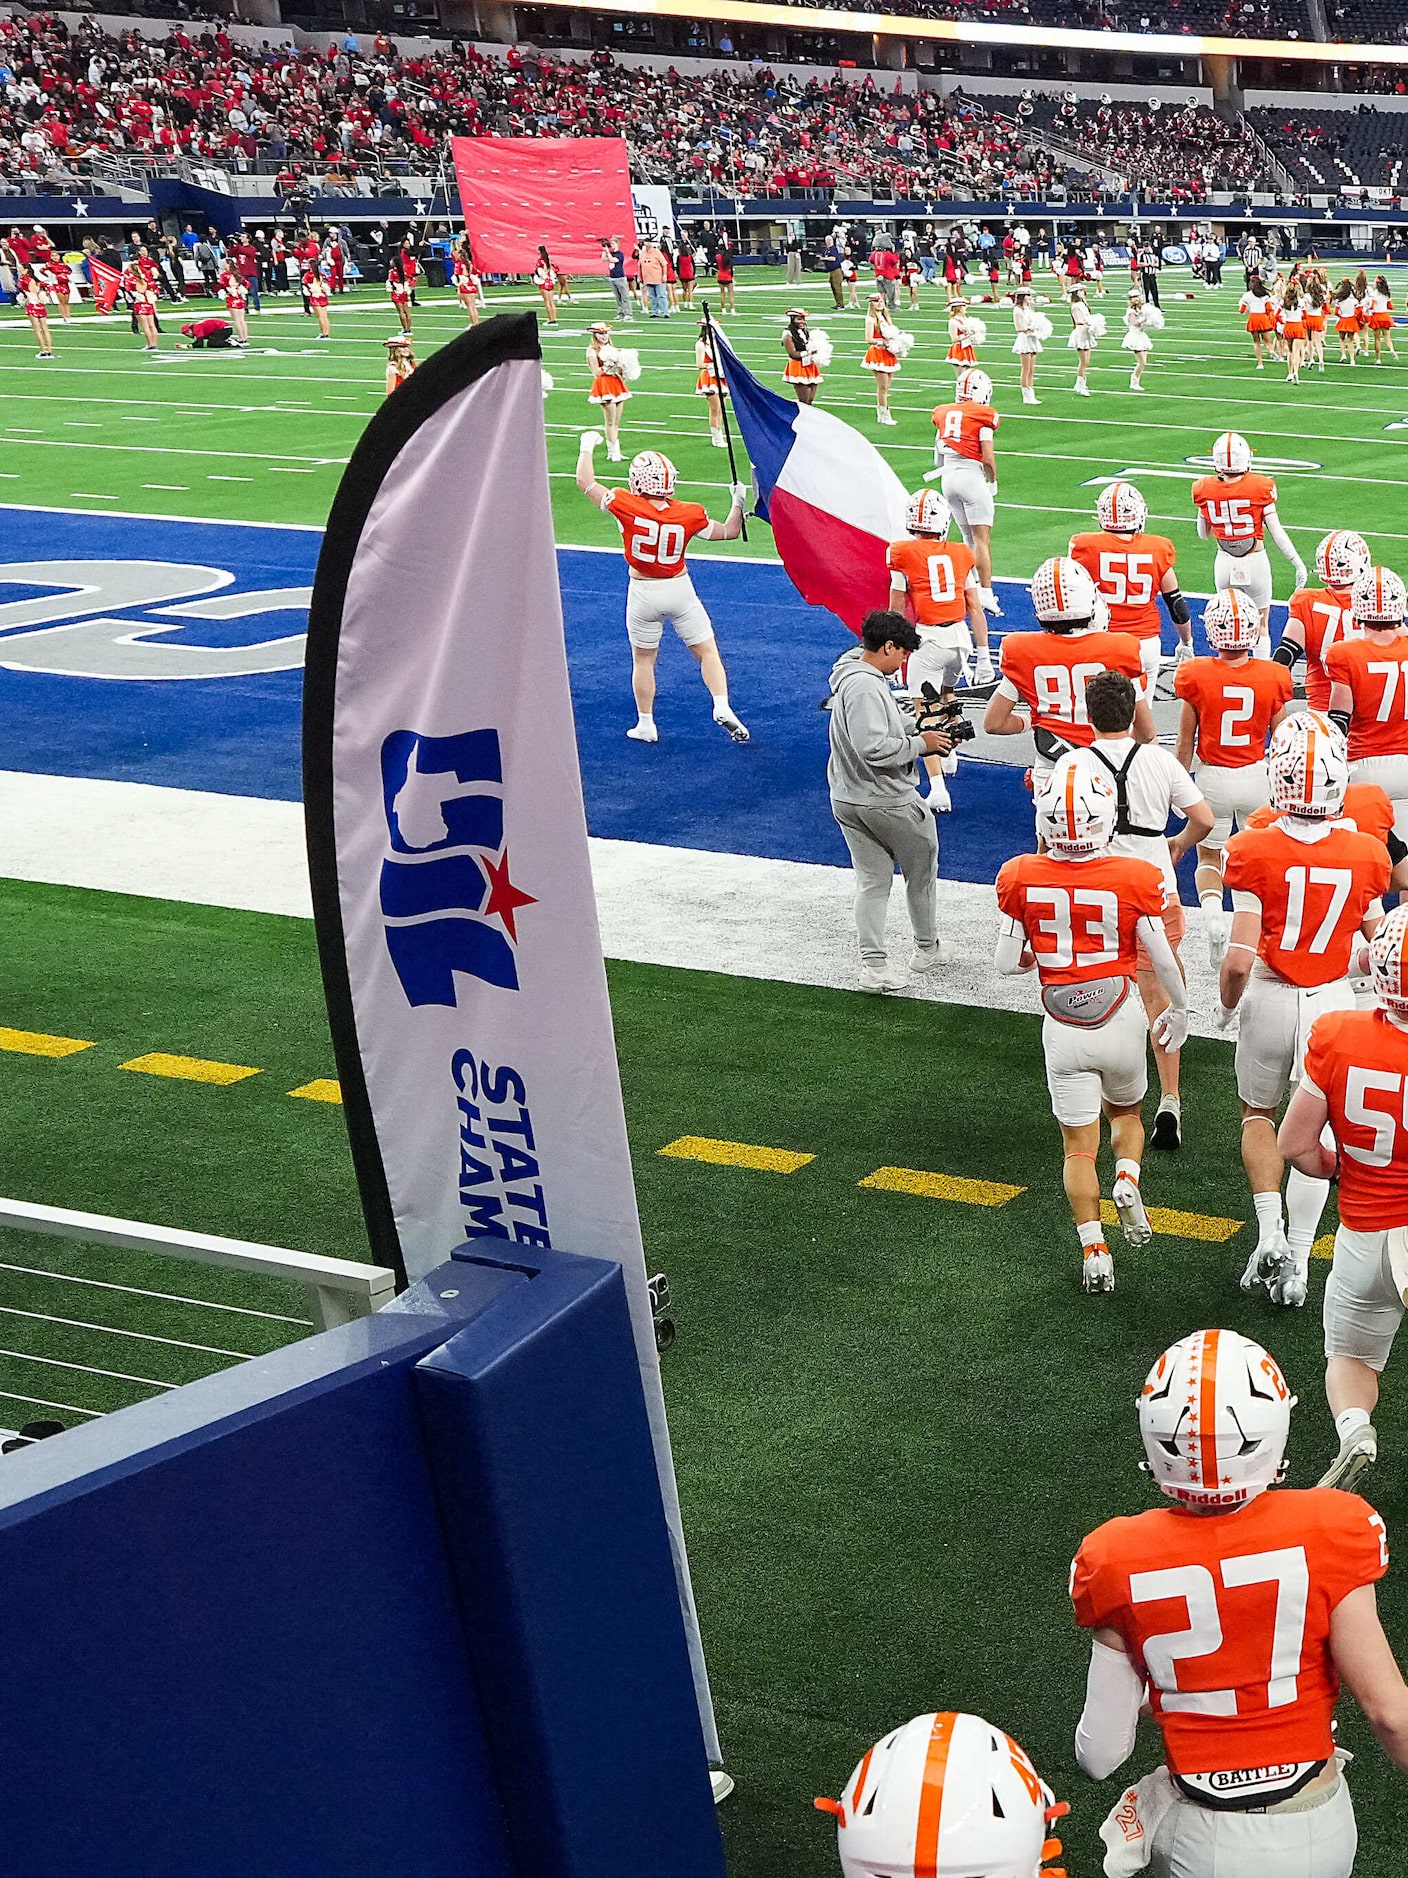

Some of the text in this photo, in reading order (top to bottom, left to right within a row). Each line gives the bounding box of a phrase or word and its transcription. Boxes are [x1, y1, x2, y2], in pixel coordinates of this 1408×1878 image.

[944, 411, 963, 442] 8
[631, 515, 685, 564] 20
[1206, 499, 1255, 536] 45
[927, 554, 956, 602] 0
[1100, 551, 1153, 605] 55
[1219, 685, 1255, 747] 2
[1287, 802, 1327, 815] Riddell
[1056, 842, 1094, 852] Riddell
[1026, 886, 1120, 969] 33
[1279, 865, 1353, 955] 17
[481, 1060, 552, 1249] STATE
[1177, 1488, 1248, 1505] Riddell
[1128, 1545, 1311, 1718] 27
[1216, 1762, 1293, 1788] BATTLE
[1115, 1805, 1144, 1843] 27
